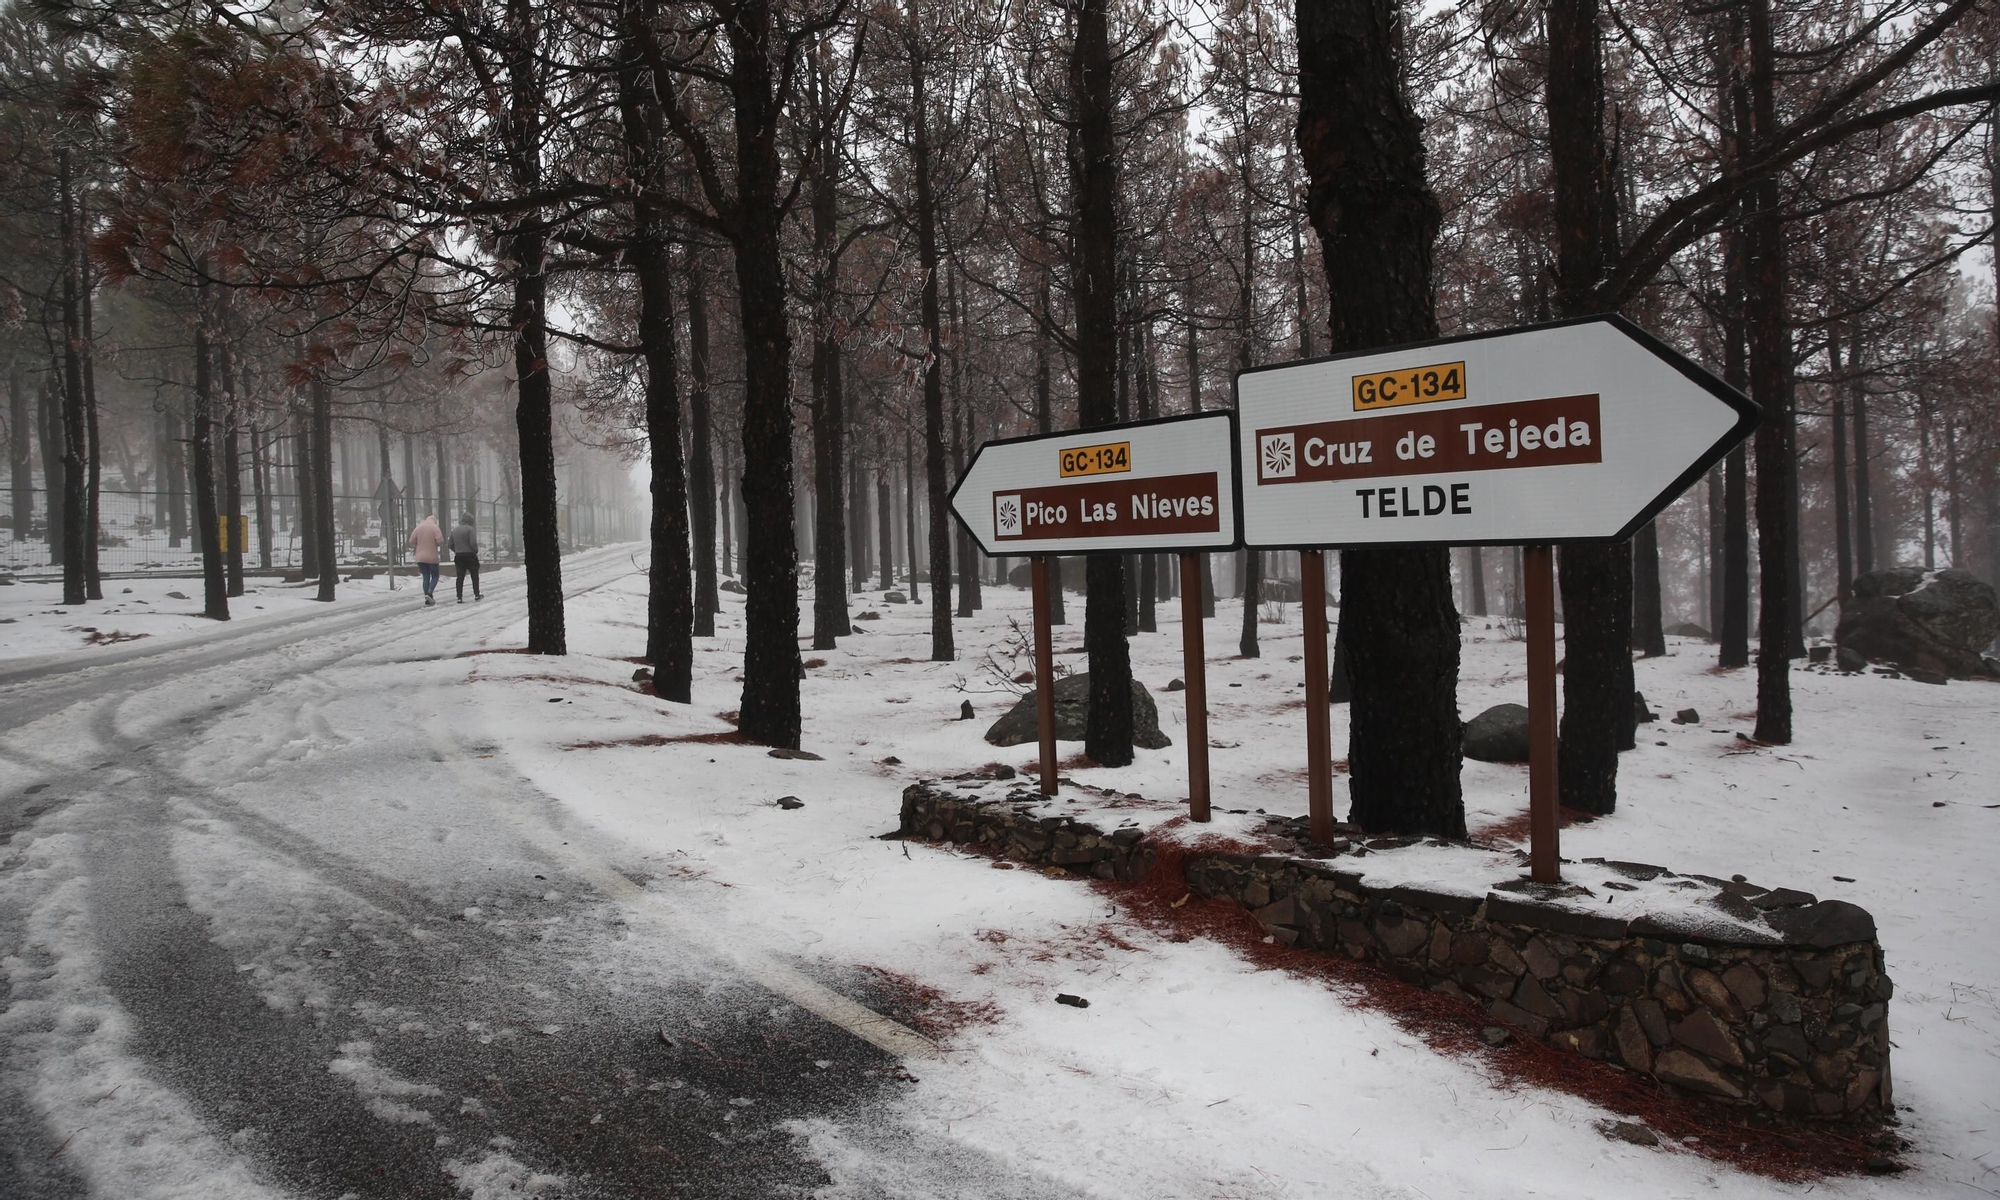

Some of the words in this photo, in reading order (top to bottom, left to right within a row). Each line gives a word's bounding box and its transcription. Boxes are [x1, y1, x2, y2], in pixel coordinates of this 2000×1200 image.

[1356, 368, 1461, 404] GC-134
[1062, 446, 1128, 473] GC-134
[1303, 437, 1373, 467] Cruz
[1395, 430, 1436, 461] de
[1459, 416, 1592, 459] Tejeda
[1026, 501, 1068, 526] Pico
[1080, 498, 1117, 523] Las
[1131, 492, 1214, 520] Nieves
[1355, 482, 1472, 519] TELDE
